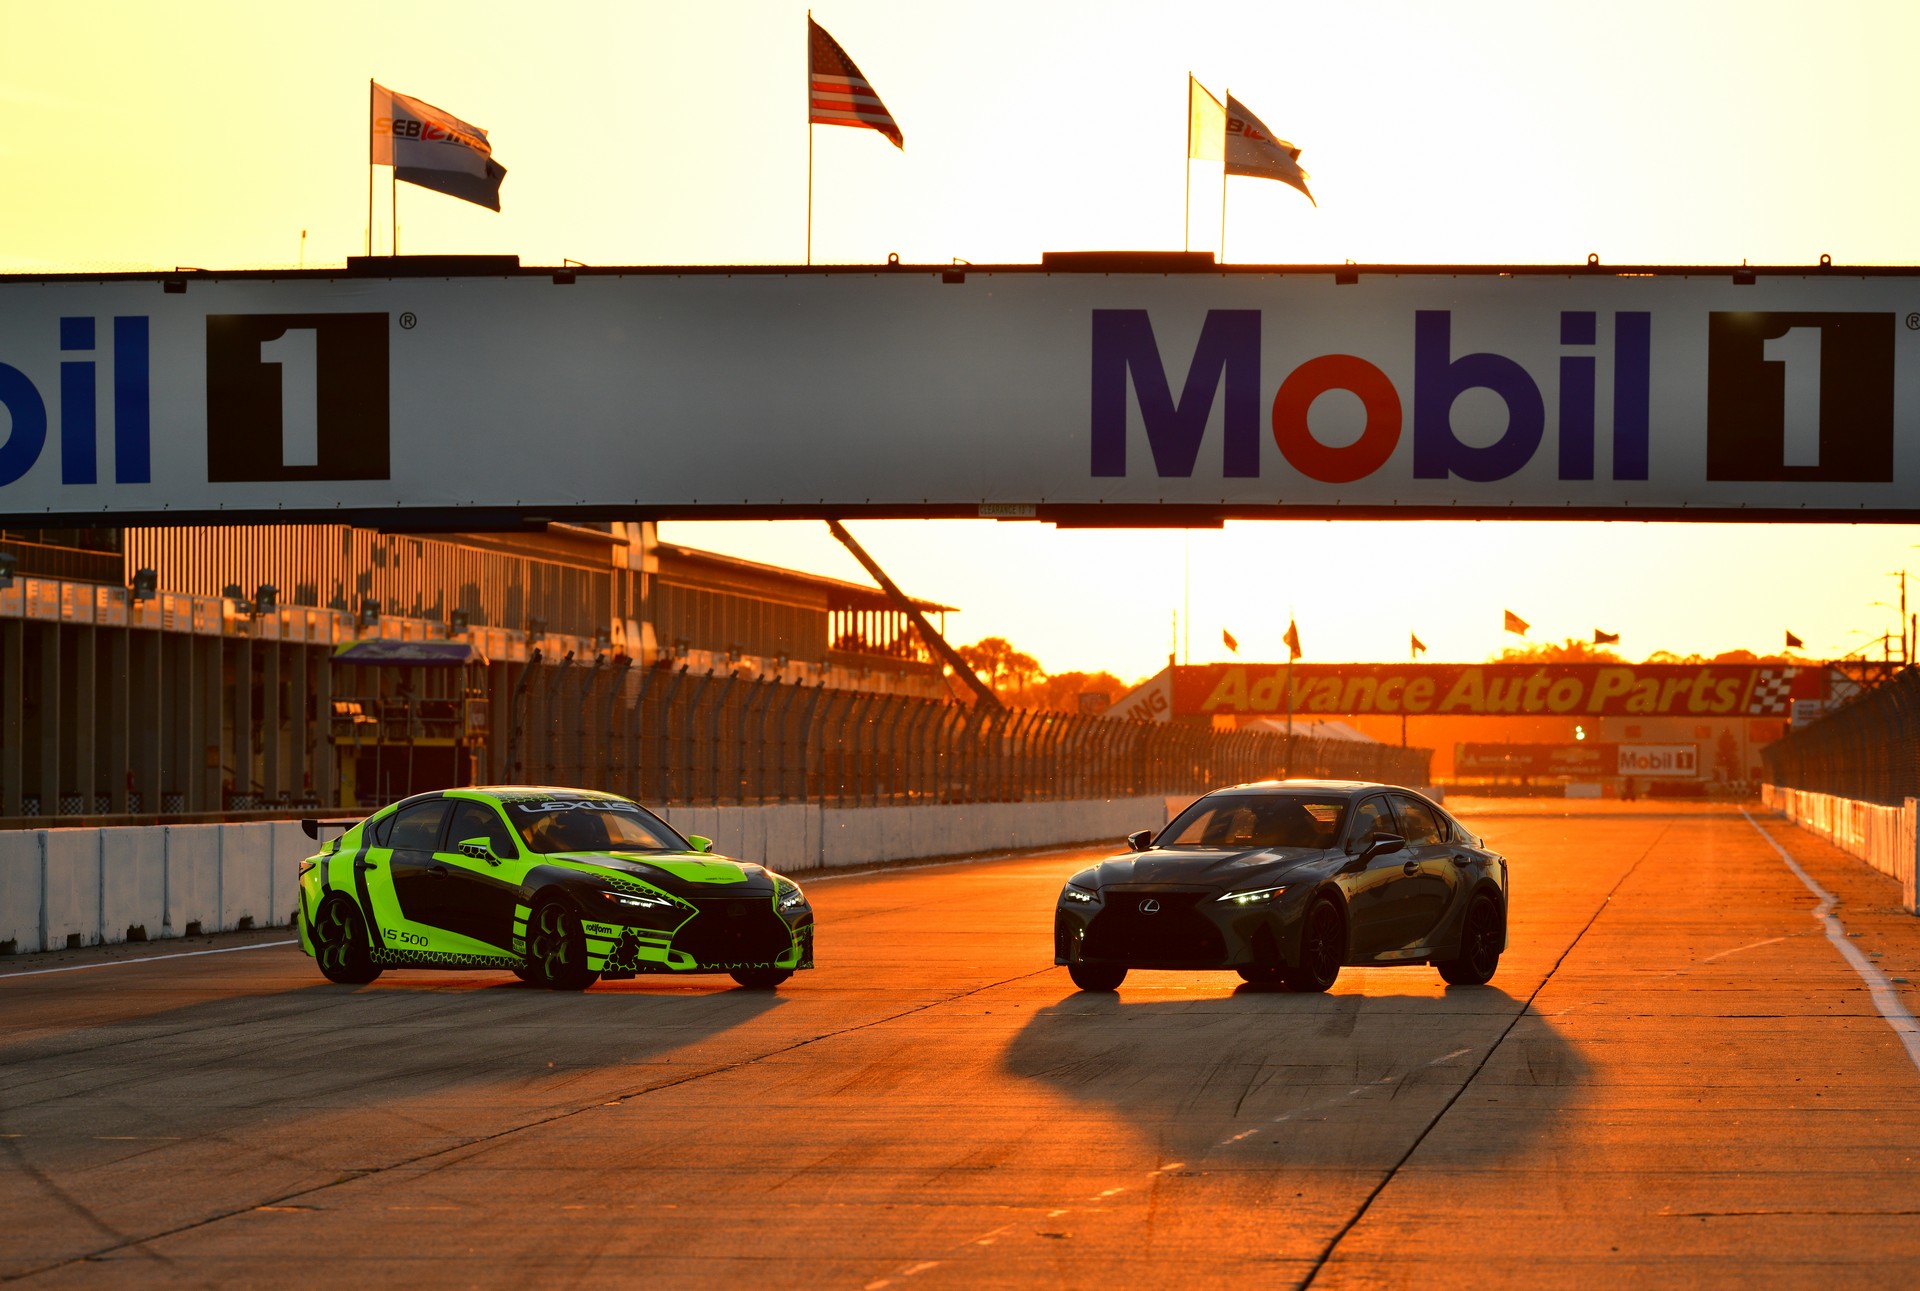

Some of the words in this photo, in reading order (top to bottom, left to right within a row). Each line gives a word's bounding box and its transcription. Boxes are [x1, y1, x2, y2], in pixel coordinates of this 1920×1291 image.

[260, 328, 318, 467] 1
[1091, 309, 1651, 484] Mobil
[1763, 327, 1821, 467] 1
[1202, 667, 1435, 713] Advance
[1438, 668, 1584, 712] Auto
[1587, 668, 1740, 712] Parts
[1620, 752, 1672, 770] Mobil
[518, 801, 639, 813] LEXUS
[383, 927, 397, 940] IS
[400, 932, 429, 947] 500
[586, 923, 612, 935] rotiform
